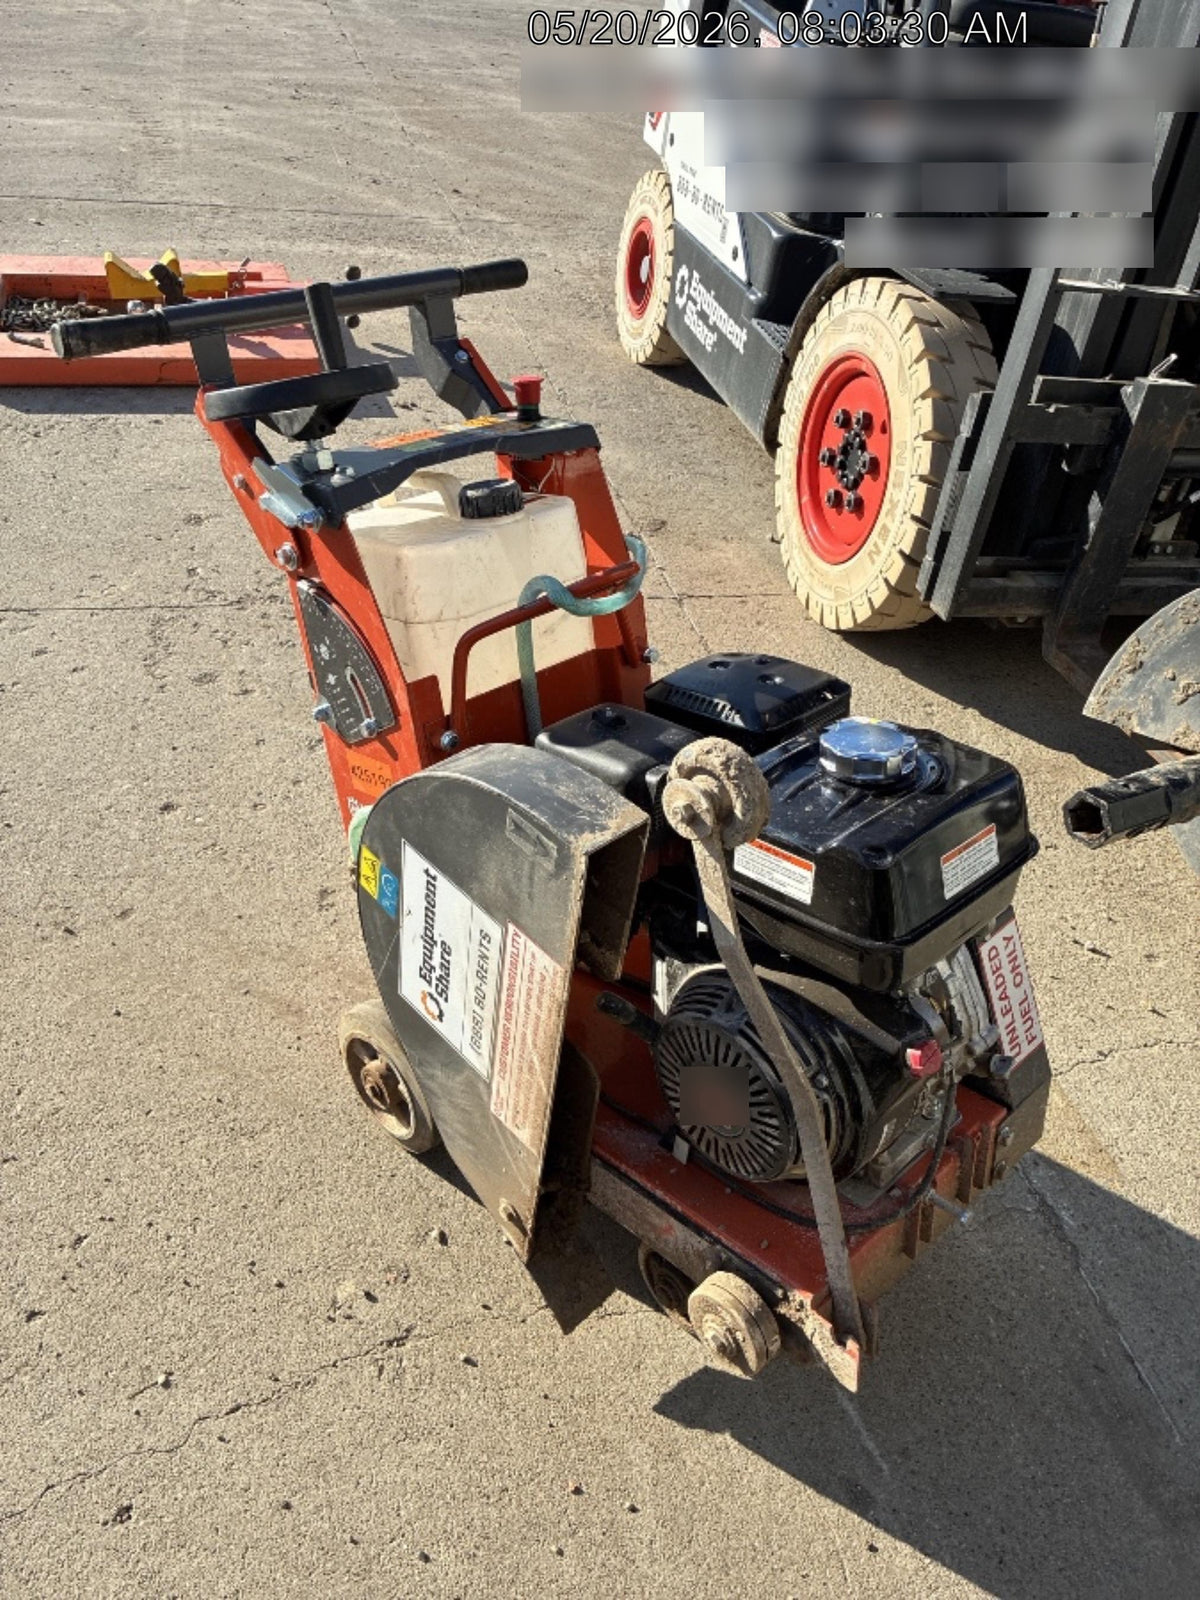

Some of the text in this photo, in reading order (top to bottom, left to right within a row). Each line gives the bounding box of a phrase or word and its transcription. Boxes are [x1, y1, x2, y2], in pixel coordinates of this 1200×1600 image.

[684, 300, 714, 353] Share
[690, 270, 748, 354] Equipment
[418, 867, 439, 989] Equipment
[473, 929, 492, 1008] 80-RENTS
[436, 938, 453, 1004] Share
[989, 945, 1021, 1058] UNLEADED
[1003, 935, 1037, 1045] FUEL ONLY
